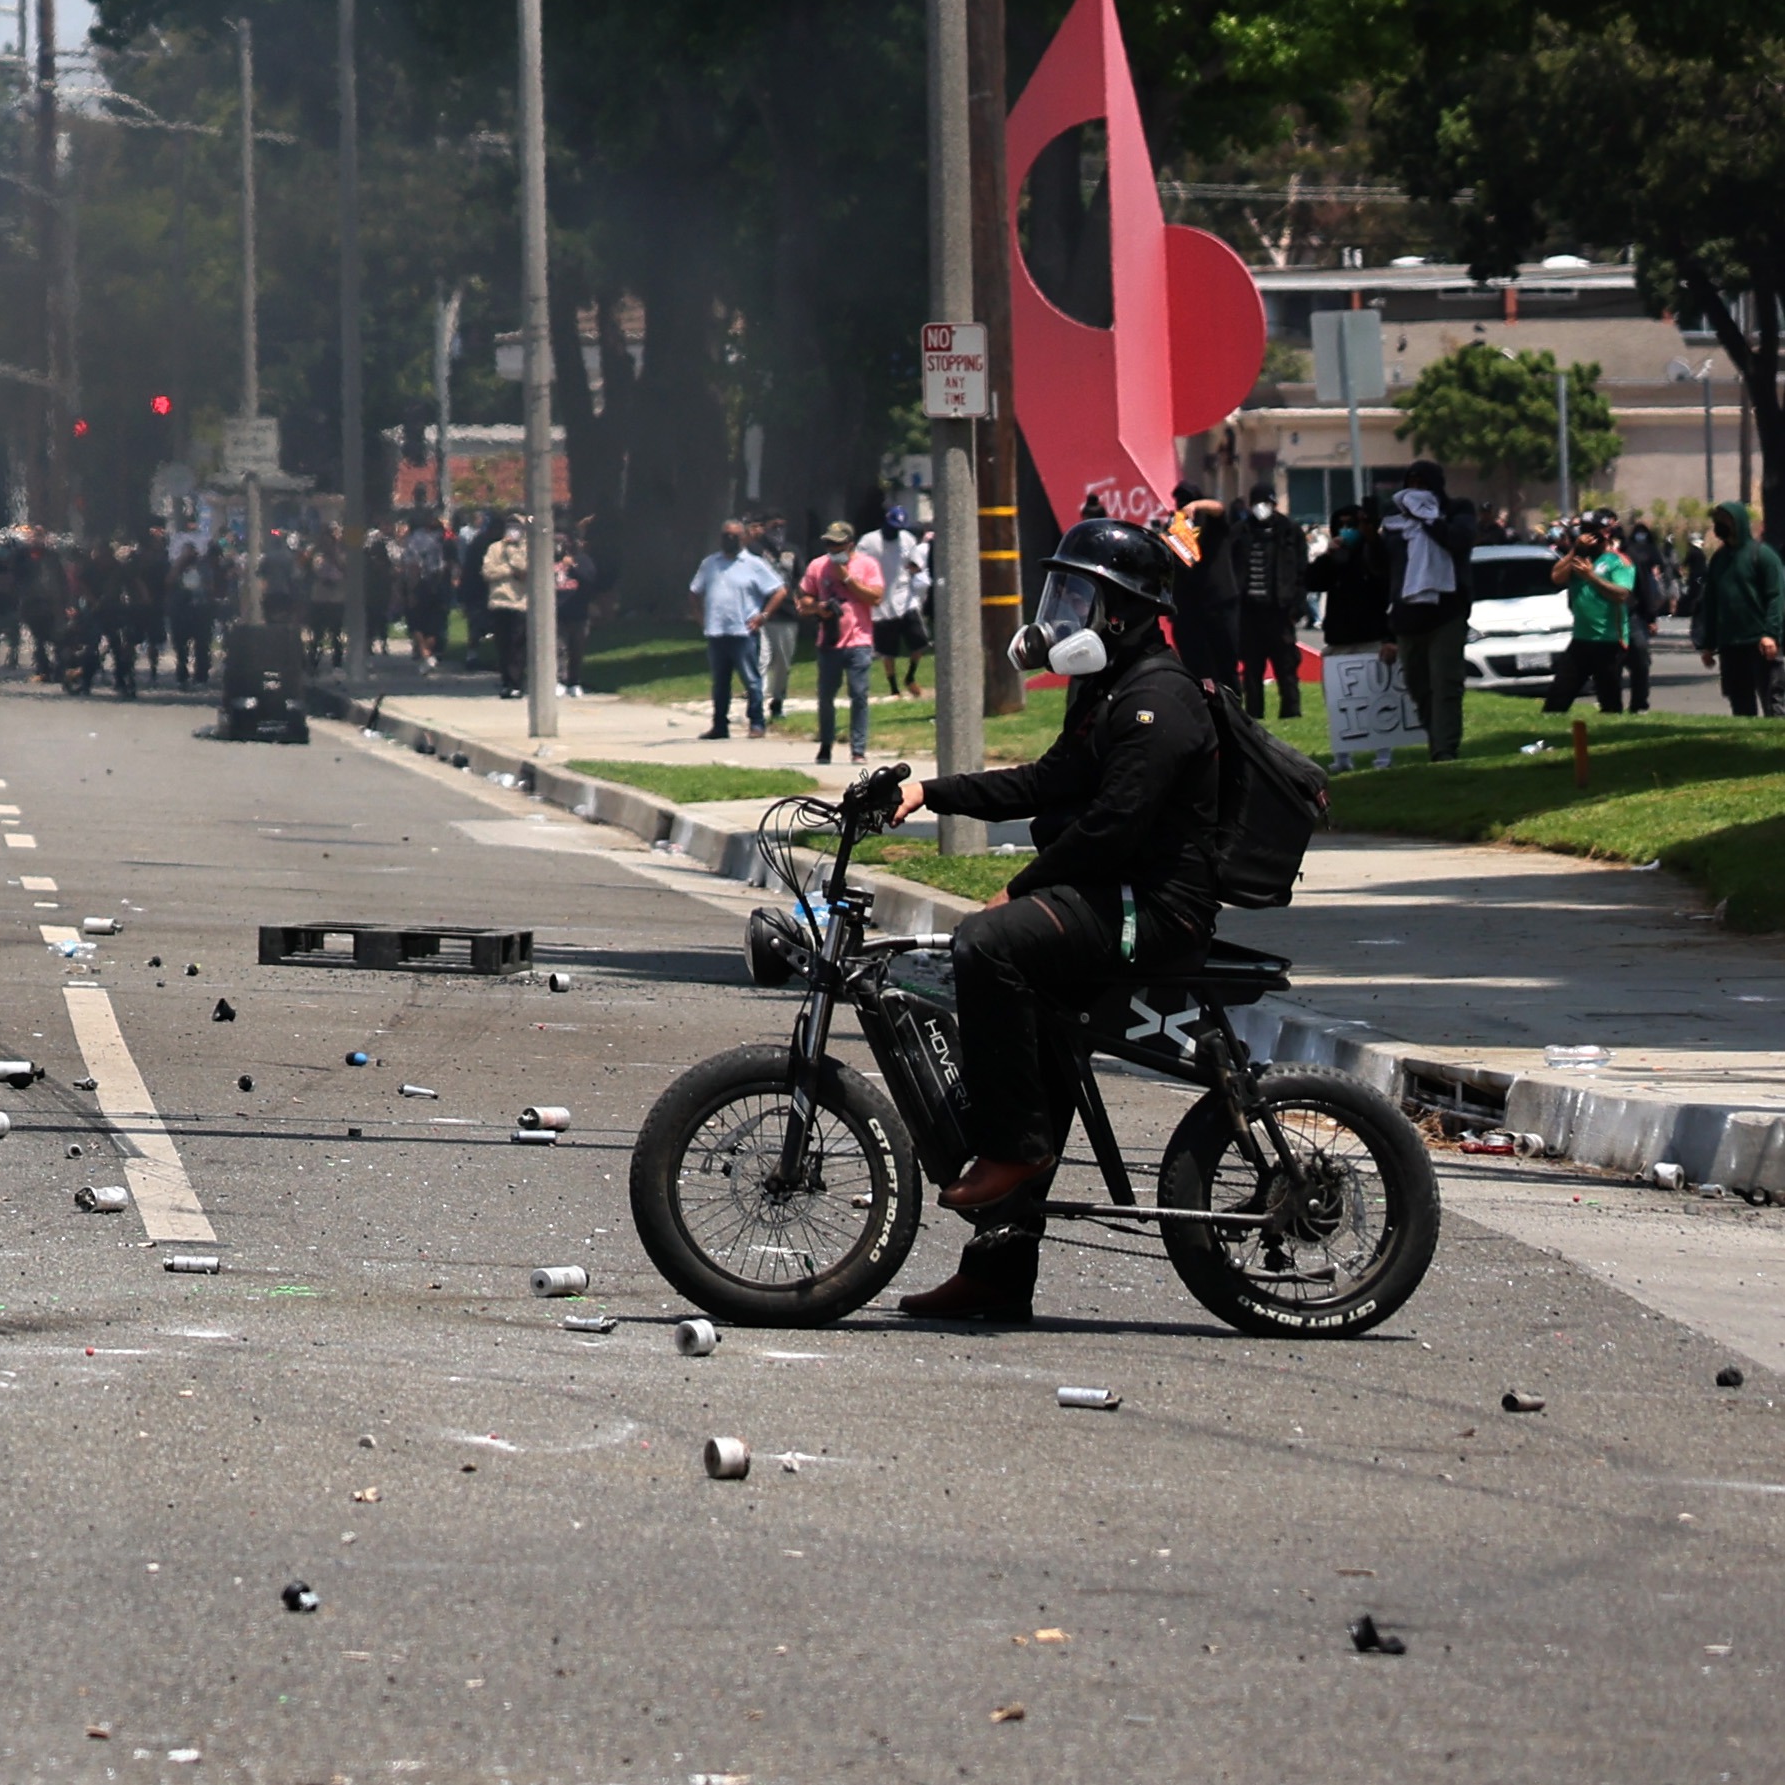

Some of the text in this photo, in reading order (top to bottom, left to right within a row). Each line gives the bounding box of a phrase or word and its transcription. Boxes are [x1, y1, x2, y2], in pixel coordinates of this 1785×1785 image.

[927, 327, 950, 348] NO
[927, 354, 983, 372] STOPPING
[944, 376, 965, 389] ANY
[944, 392, 966, 406] TIME
[924, 1018, 971, 1111] HOVER-1
[867, 1117, 892, 1151] CST
[1347, 1299, 1377, 1323] CST
